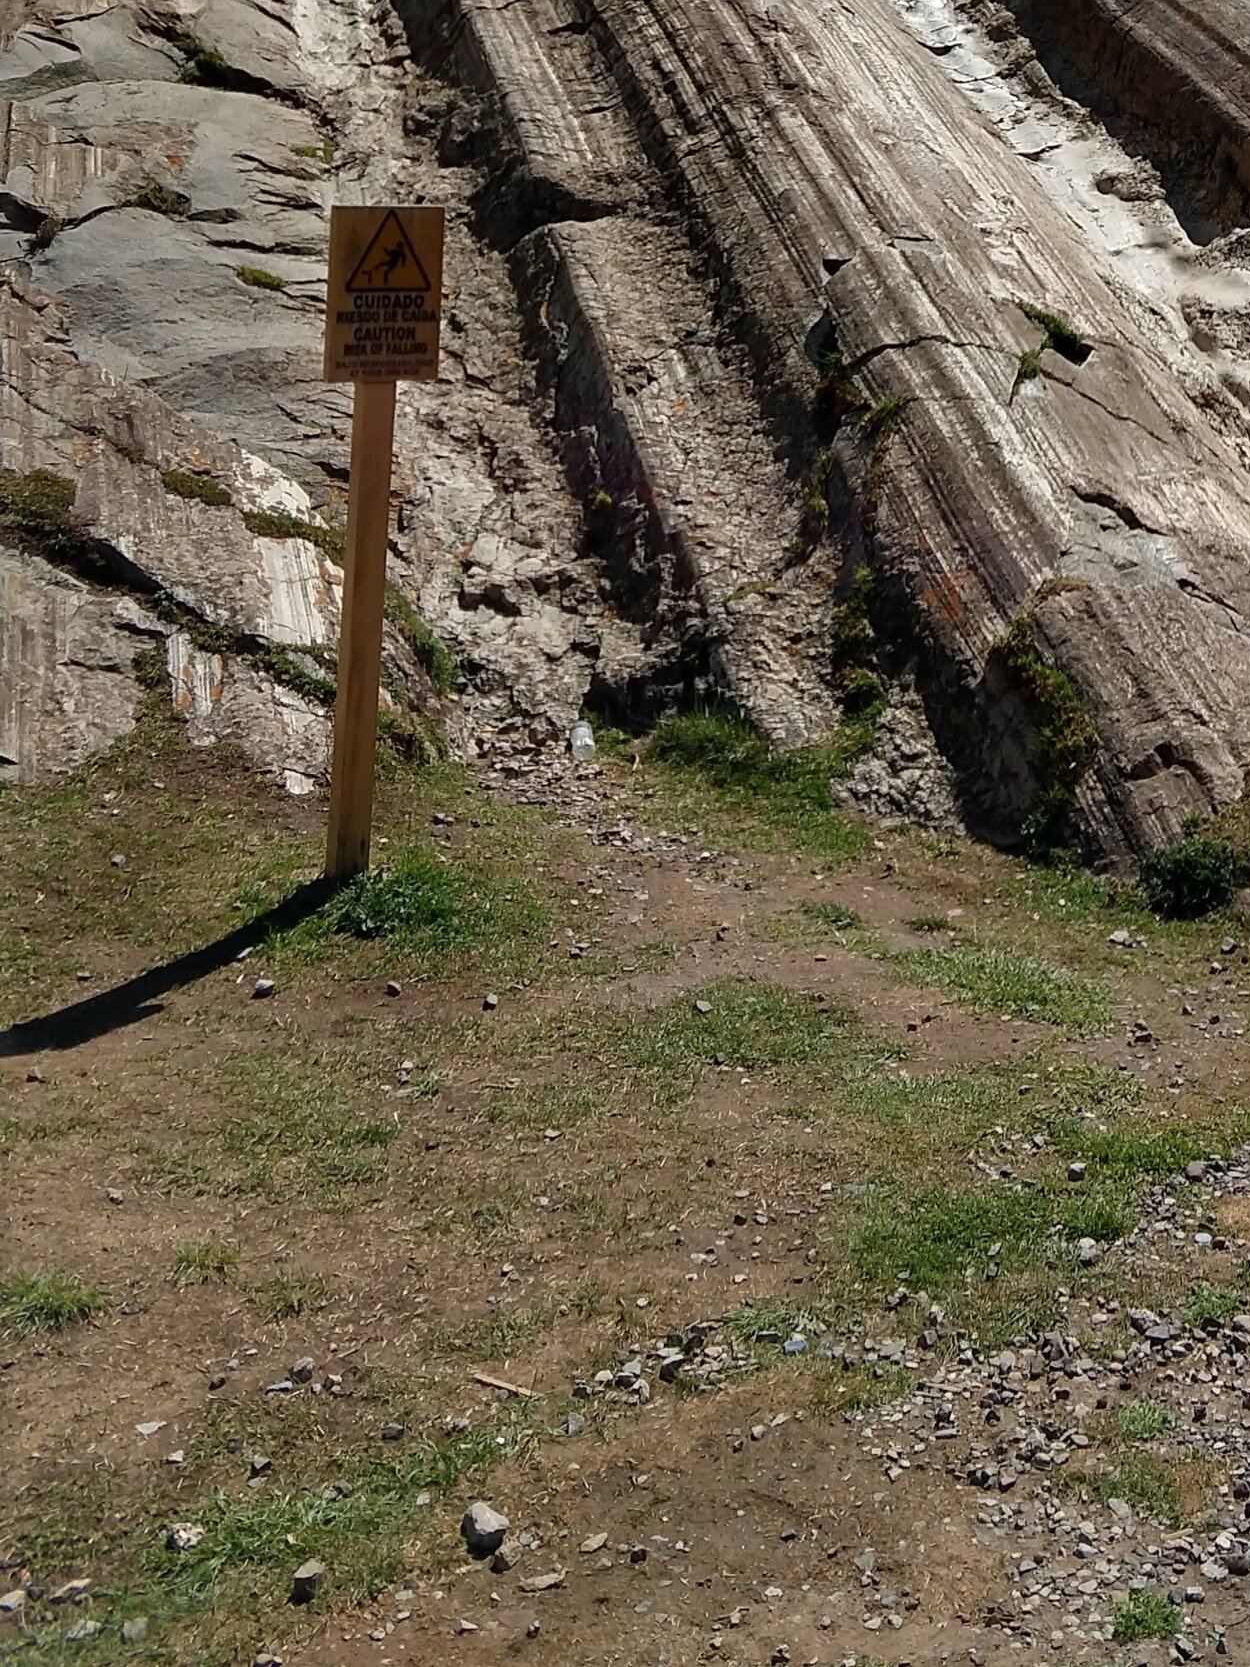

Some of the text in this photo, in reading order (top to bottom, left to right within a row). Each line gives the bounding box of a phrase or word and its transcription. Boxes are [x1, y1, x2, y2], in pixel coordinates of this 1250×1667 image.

[353, 294, 425, 309] CUIDADO
[336, 310, 380, 323] RIESGO
[383, 309, 398, 322] DE
[354, 326, 416, 341] CAUTION
[370, 343, 383, 355] OF
[386, 342, 428, 355] FALLING
